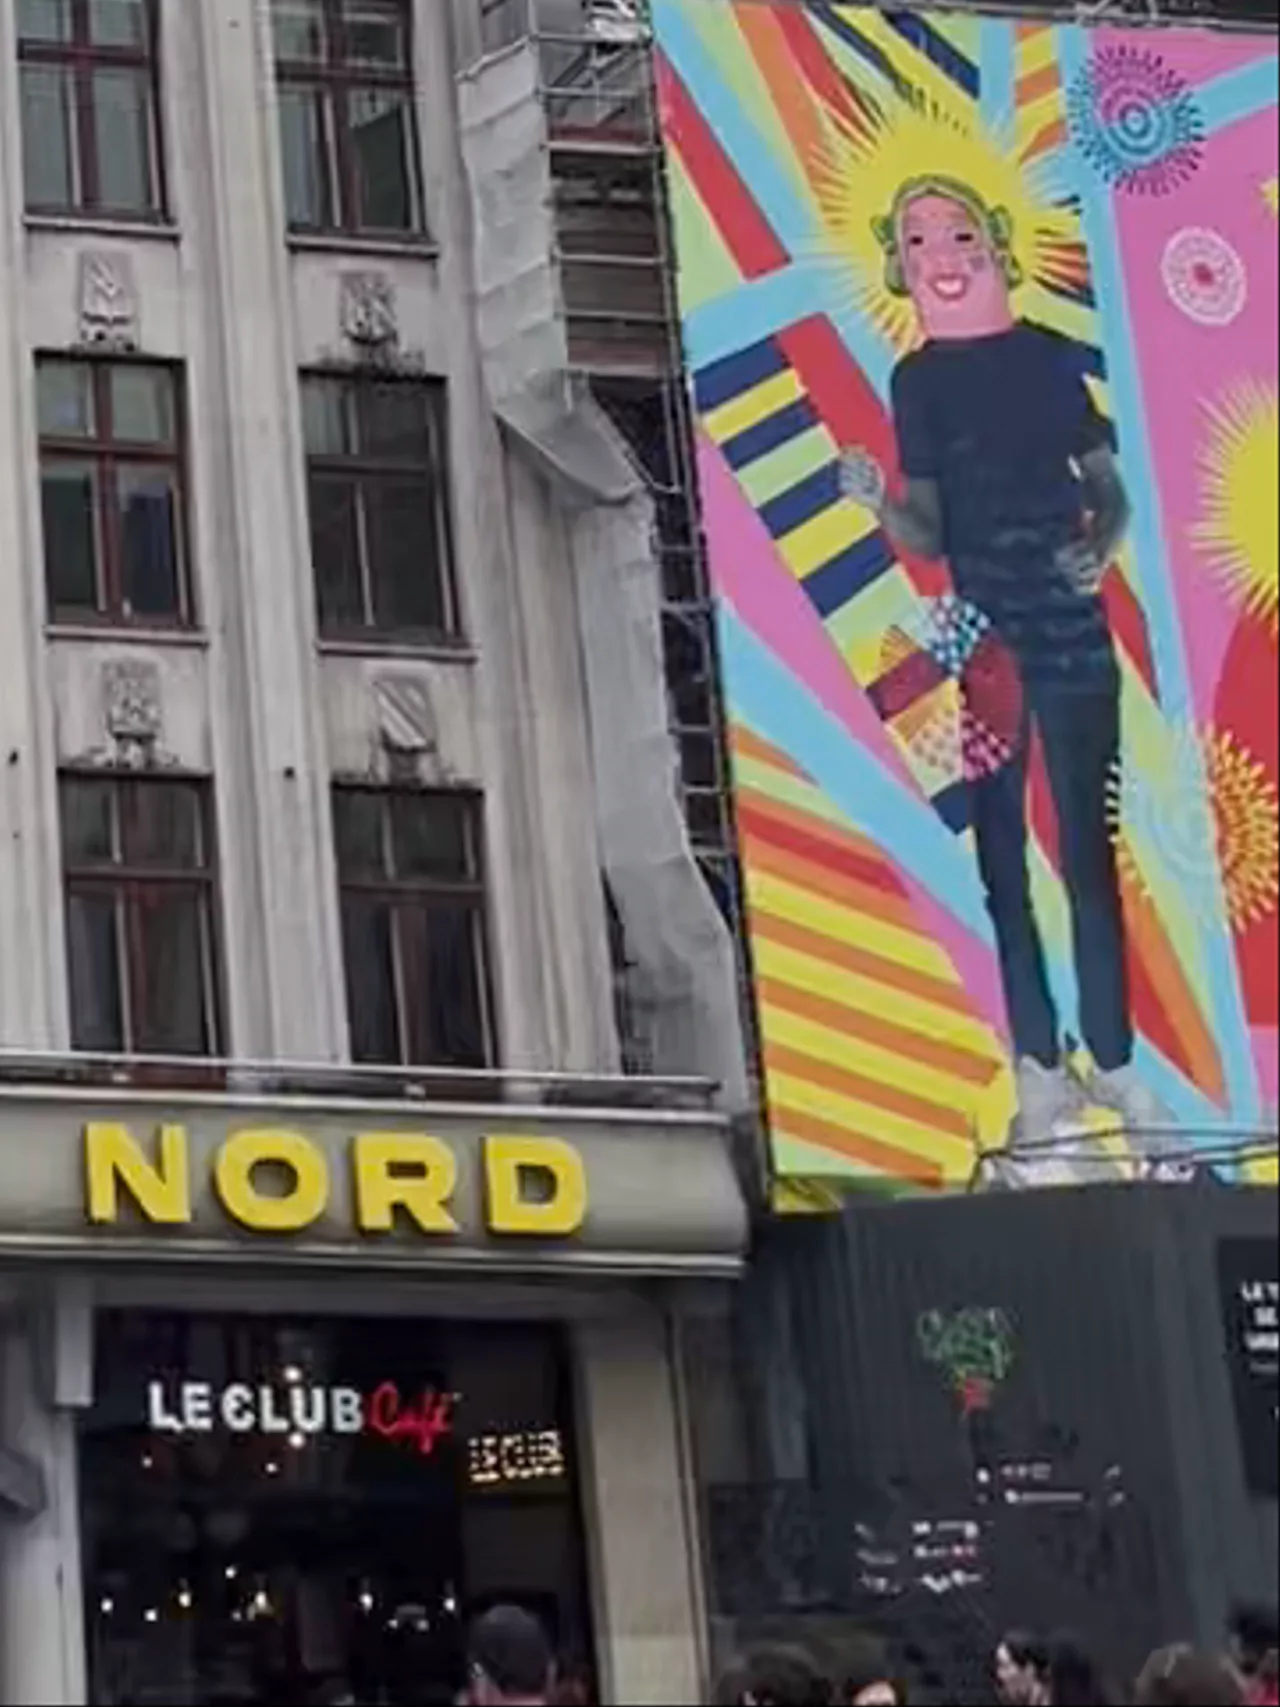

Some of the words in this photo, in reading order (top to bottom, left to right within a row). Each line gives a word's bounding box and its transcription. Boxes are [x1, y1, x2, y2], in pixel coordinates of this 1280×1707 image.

[83, 1120, 588, 1236] NORD
[147, 1381, 213, 1431] LE
[221, 1385, 365, 1434] CLUB
